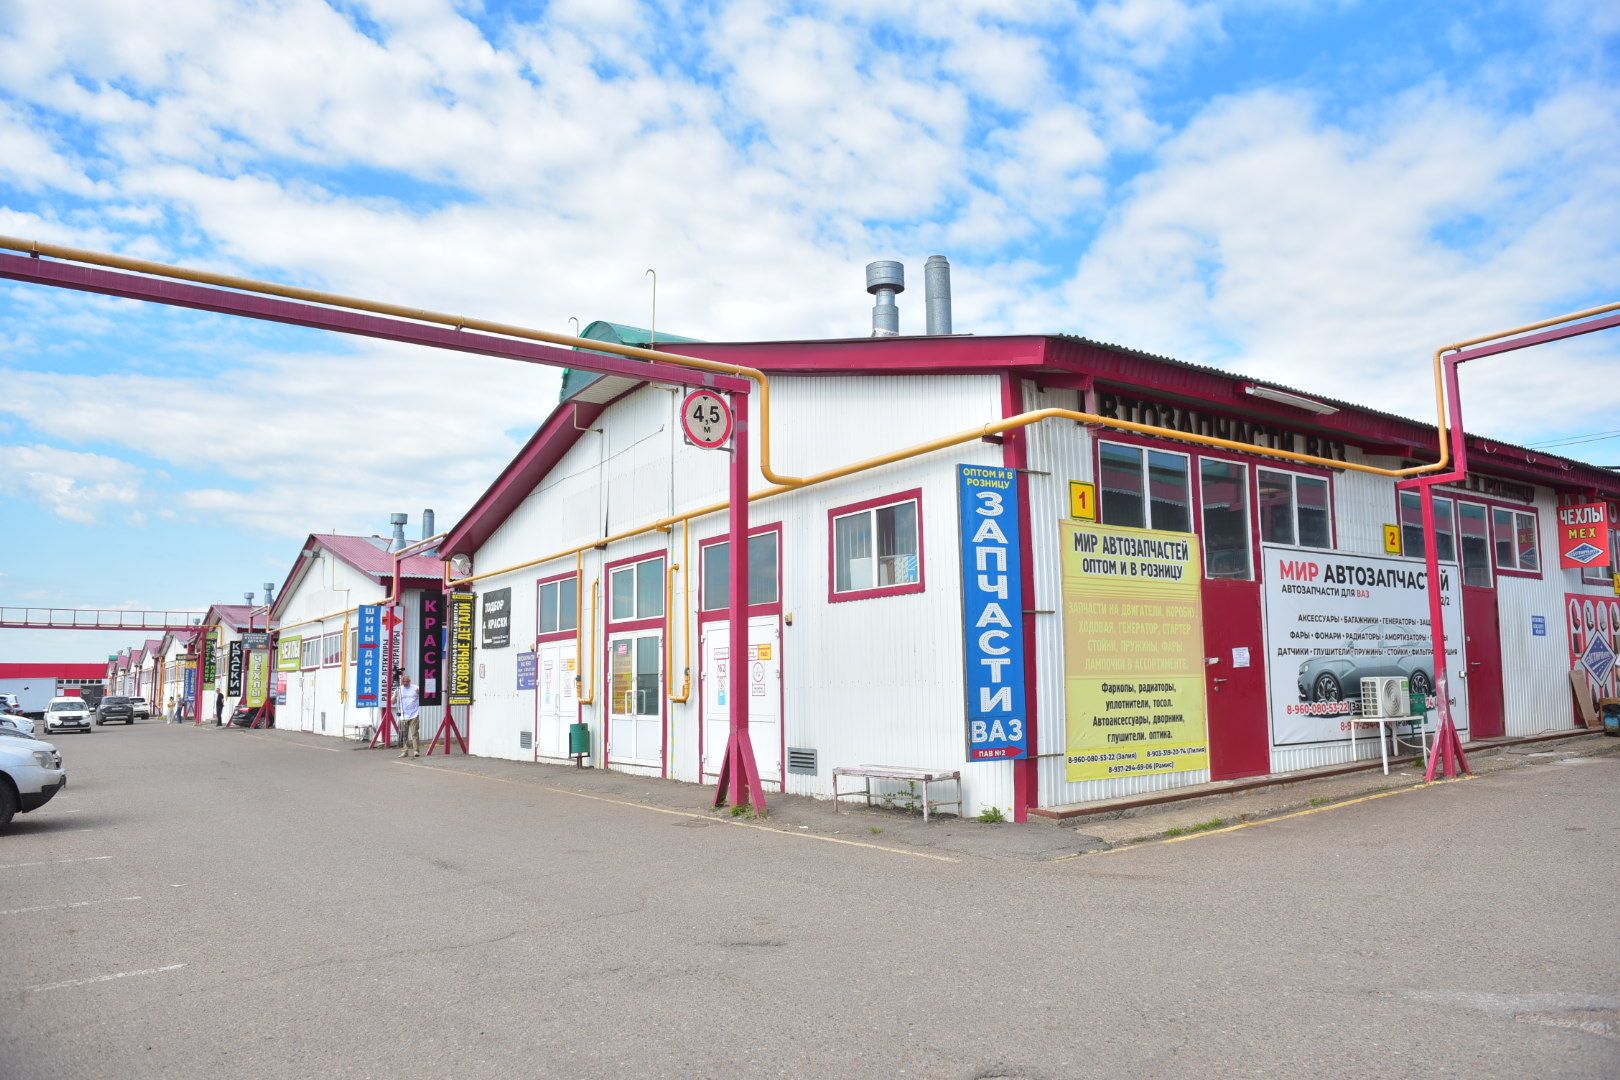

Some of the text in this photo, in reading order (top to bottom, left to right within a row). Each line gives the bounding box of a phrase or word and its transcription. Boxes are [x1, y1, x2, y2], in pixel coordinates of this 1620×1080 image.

[693, 405, 720, 425] 4,5
[963, 468, 1013, 480] ОПТОМ И В
[967, 478, 1010, 489] РОЗНИЦУ
[1079, 491, 1086, 509] 1
[1560, 507, 1604, 525] ЧЕХЛЫ
[1389, 532, 1396, 545] 2
[1568, 528, 1596, 539] МЕХ
[1074, 532, 1189, 561] МИР АВТОЗАПЧАСТЕЙ
[1082, 558, 1183, 580] ОПТОМ И В РОЗНИЦУ
[1279, 559, 1449, 592] МИР АВТОЗАПЧАСЙ
[1282, 584, 1370, 598] АВТОЗАПЧАСТИ ДЛЯ ВАЗ
[972, 491, 1012, 713] ЗАПЧАСТИ
[1109, 603, 1119, 615] НА
[364, 608, 375, 642] ШИНЫ
[458, 603, 472, 640] ДЕТАЛИ
[488, 617, 508, 630] КРАСКИ
[1298, 614, 1340, 624] АКСЕССУАРЫ
[1344, 616, 1379, 624] БАГАЖНИКИ
[1382, 617, 1416, 626] ГЕНЕРАТОРЫ
[1290, 631, 1310, 640] ФАРЫ
[1314, 632, 1342, 640] ФОНАРИ
[1345, 633, 1382, 642] РАДИАТОРЫ
[1385, 634, 1427, 642] АМОРТИЗАТОРЫ
[1278, 647, 1310, 657] ДАТЧИКИ
[1313, 648, 1351, 657] ГЛУШИТЕЛИ
[1354, 648, 1384, 657] ПРУЖИНЫ
[1387, 647, 1409, 657] СТОЙКИ
[230, 643, 241, 688] КРАСКИ
[364, 650, 373, 693] ДИСКИ
[457, 643, 470, 695] КУЗОВНЫЕ
[251, 655, 262, 697] ЧЕХЛЫ
[1101, 682, 1177, 695] Фаркопы, радиаторы,
[1105, 699, 1151, 712] уплотнители,
[1286, 702, 1348, 715] 8-960-080-53-22
[1092, 714, 1185, 728] Автоаксессуары, дворники,
[971, 719, 1023, 743] ВАЗ
[1068, 753, 1115, 764] 8-960-080-53-22
